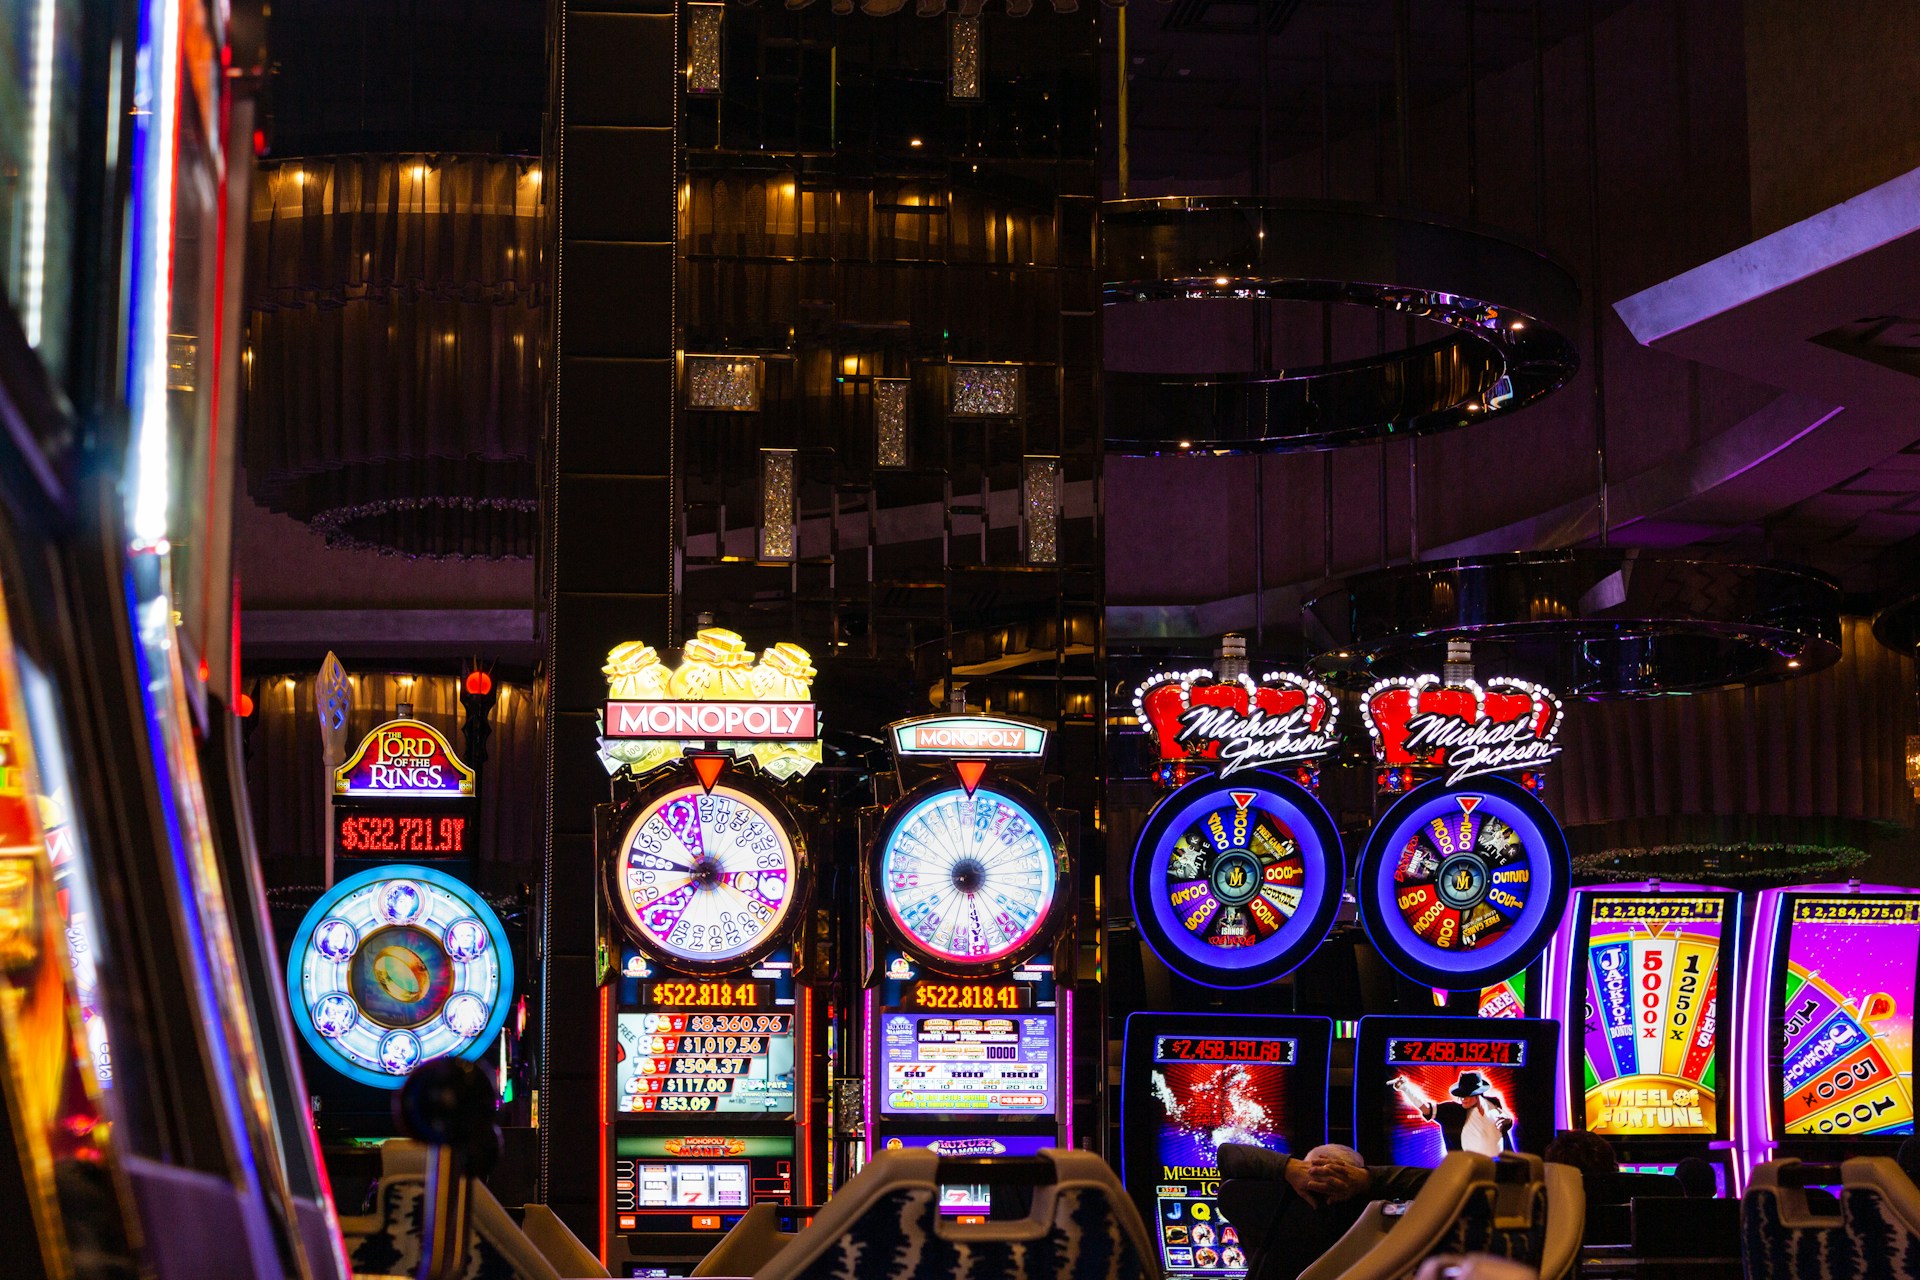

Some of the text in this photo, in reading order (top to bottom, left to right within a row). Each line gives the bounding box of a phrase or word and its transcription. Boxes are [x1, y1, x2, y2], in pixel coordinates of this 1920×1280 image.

[618, 705, 804, 734] MONOPOLY
[1179, 706, 1310, 742] Michael
[920, 730, 1022, 747] MONOPOLY
[1407, 714, 1535, 750] Michael
[376, 732, 435, 765] LORD
[1219, 732, 1339, 780] Jackson
[394, 758, 430, 767] OF THE
[1445, 740, 1562, 788] Jackson
[700, 797, 714, 822] 25
[715, 799, 732, 834] 100
[730, 808, 750, 831] 45
[648, 818, 671, 840] 30
[1207, 811, 1230, 850] 4500
[1256, 824, 1287, 857] FREE GAMES
[1431, 817, 1454, 855] 3000
[1459, 813, 1473, 850] 1200
[1486, 825, 1516, 856] BLCK
[638, 833, 662, 853] 60
[1478, 835, 1507, 866] WHITE
[632, 854, 673, 870] 1000
[1177, 837, 1199, 874] BLCK
[1188, 842, 1210, 879] WHITE
[1266, 866, 1303, 880] 1800
[1492, 869, 1529, 884] 2250
[633, 886, 659, 904] 20
[1171, 883, 1208, 906] 2400
[1398, 889, 1427, 910] 600
[1488, 888, 1524, 909] 1500
[1184, 898, 1217, 931] 6000
[1251, 899, 1278, 931] 1200
[1413, 901, 1445, 935] 30000
[1483, 914, 1500, 929] FREE
[671, 920, 690, 946] 25
[689, 925, 705, 950] 75
[708, 925, 722, 951] 50
[720, 912, 741, 946] 200
[1221, 927, 1244, 936] BONUS!
[1437, 918, 1455, 948] 900
[653, 983, 757, 1006] $522,818.41
[916, 985, 1018, 1008] $522,818.41
[1601, 948, 1626, 1026] JACKPOT
[1478, 991, 1515, 1018] FREE
[618, 1023, 637, 1044] FREE
[691, 1016, 782, 1033] $8,360.96
[1610, 1024, 1633, 1039] BONUS
[683, 1037, 762, 1054] $1,019.56
[987, 1047, 1016, 1059] 10000
[1786, 1024, 1858, 1082] JACKPOT
[675, 1058, 744, 1074] $504.37
[667, 1078, 727, 1092] $117.00
[767, 1081, 787, 1089] PAYS
[660, 1097, 711, 1111] $53.09
[1601, 1089, 1673, 1107] WHEEL
[1597, 1107, 1703, 1128] FORTUNE
[678, 1146, 733, 1157] MONEY
[938, 1147, 994, 1156] DIAMONDS
[939, 1139, 995, 1148] LUXURY
[1163, 1166, 1221, 1181] MICHAE
[1166, 1202, 1182, 1220] J
[1191, 1202, 1211, 1221] Q
[1221, 1227, 1239, 1244] A
